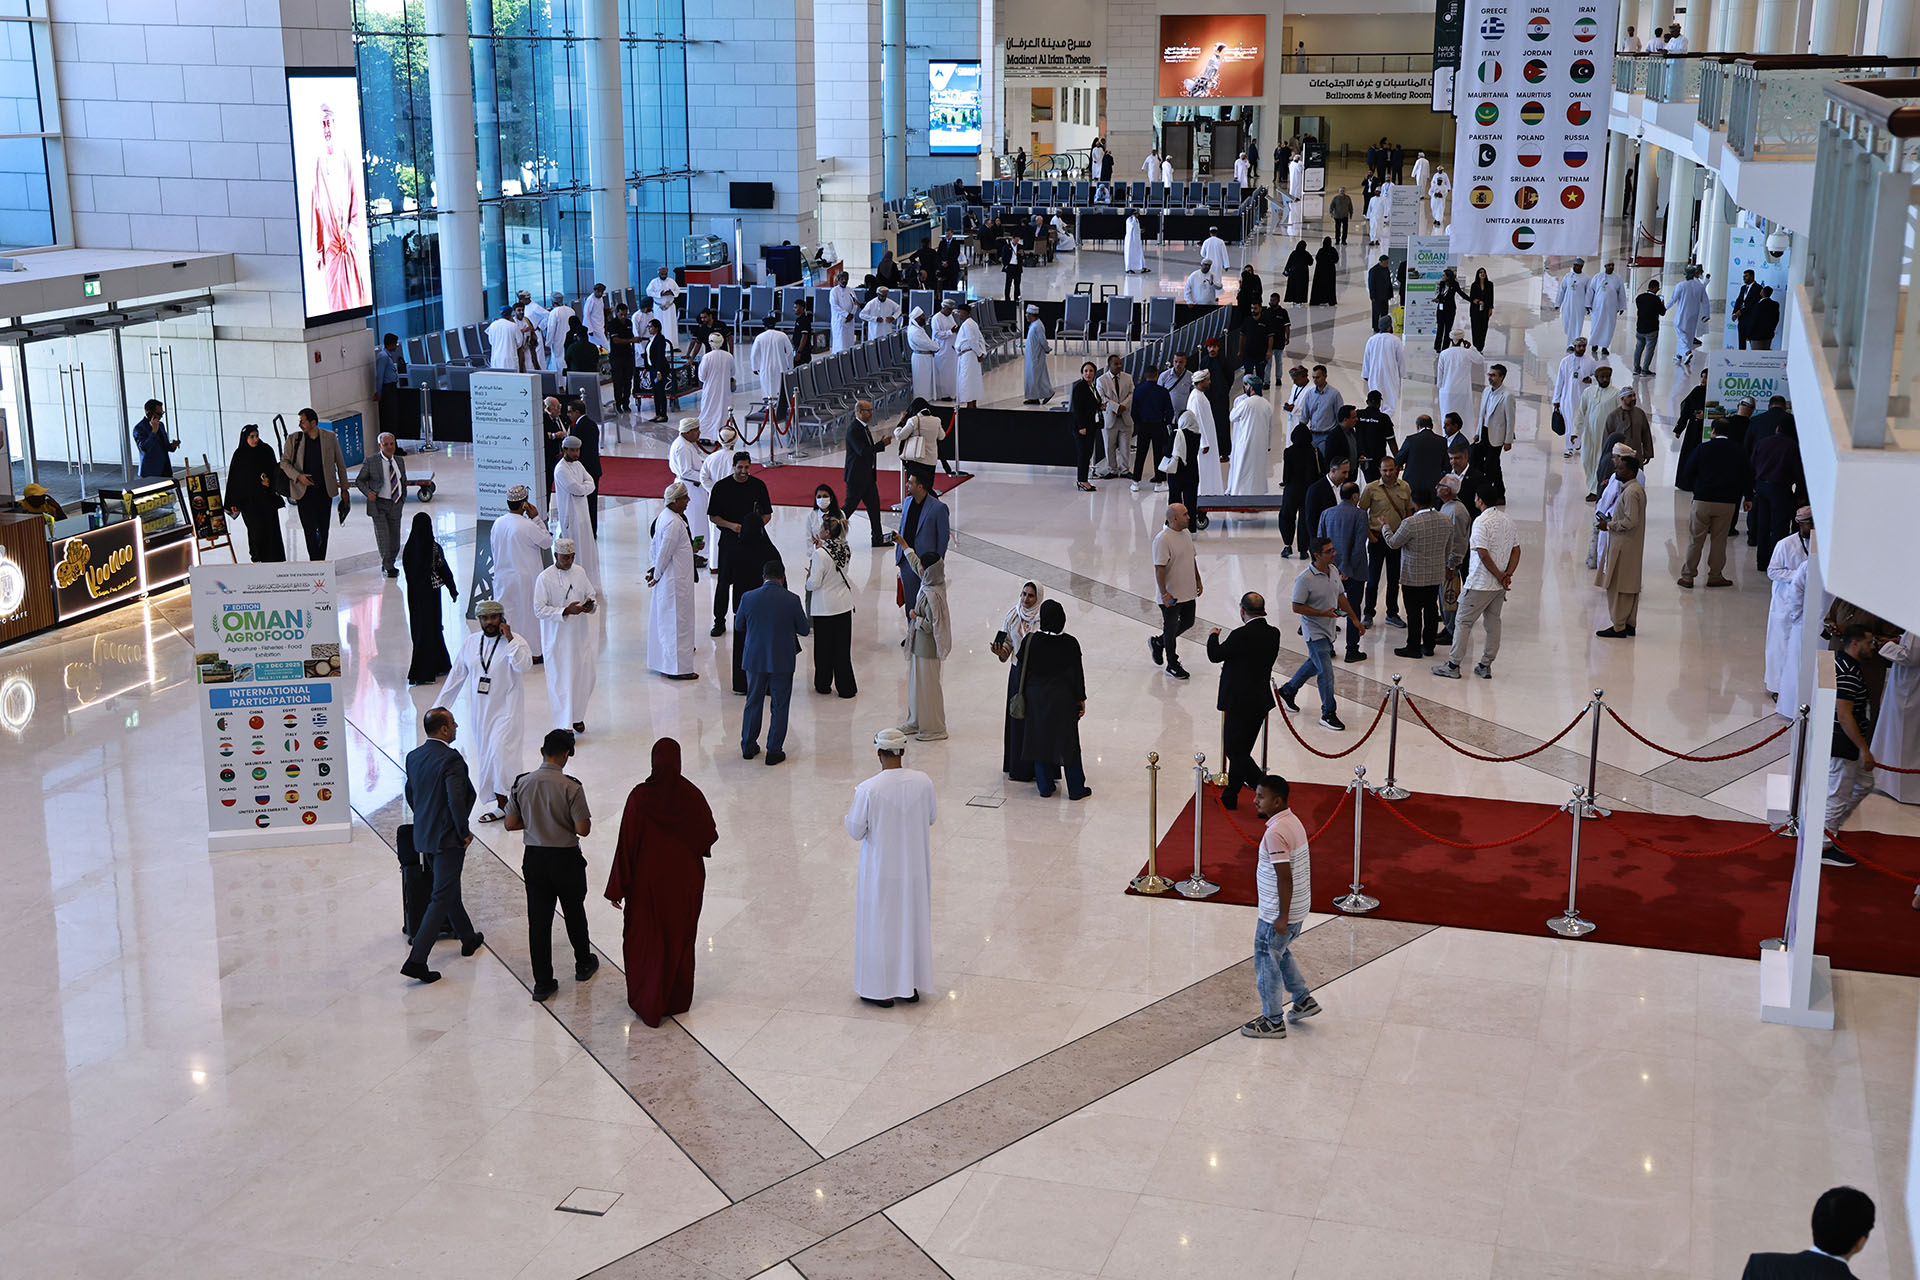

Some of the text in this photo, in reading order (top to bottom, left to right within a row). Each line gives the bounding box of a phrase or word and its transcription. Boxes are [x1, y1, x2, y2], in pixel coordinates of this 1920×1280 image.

[1006, 37, 1092, 51] مسرح مدينة العرفان
[1007, 54, 1091, 64] Madinat Al Irfan Theatre
[1374, 92, 1407, 100] Meeting
[1409, 91, 1432, 99] Room
[1724, 377, 1774, 390] OMAN
[222, 610, 303, 631] OMAN
[224, 629, 304, 643] AGROFOOD
[229, 686, 310, 697] INTERNATIONAL
[232, 695, 310, 706] PARTICIPATION
